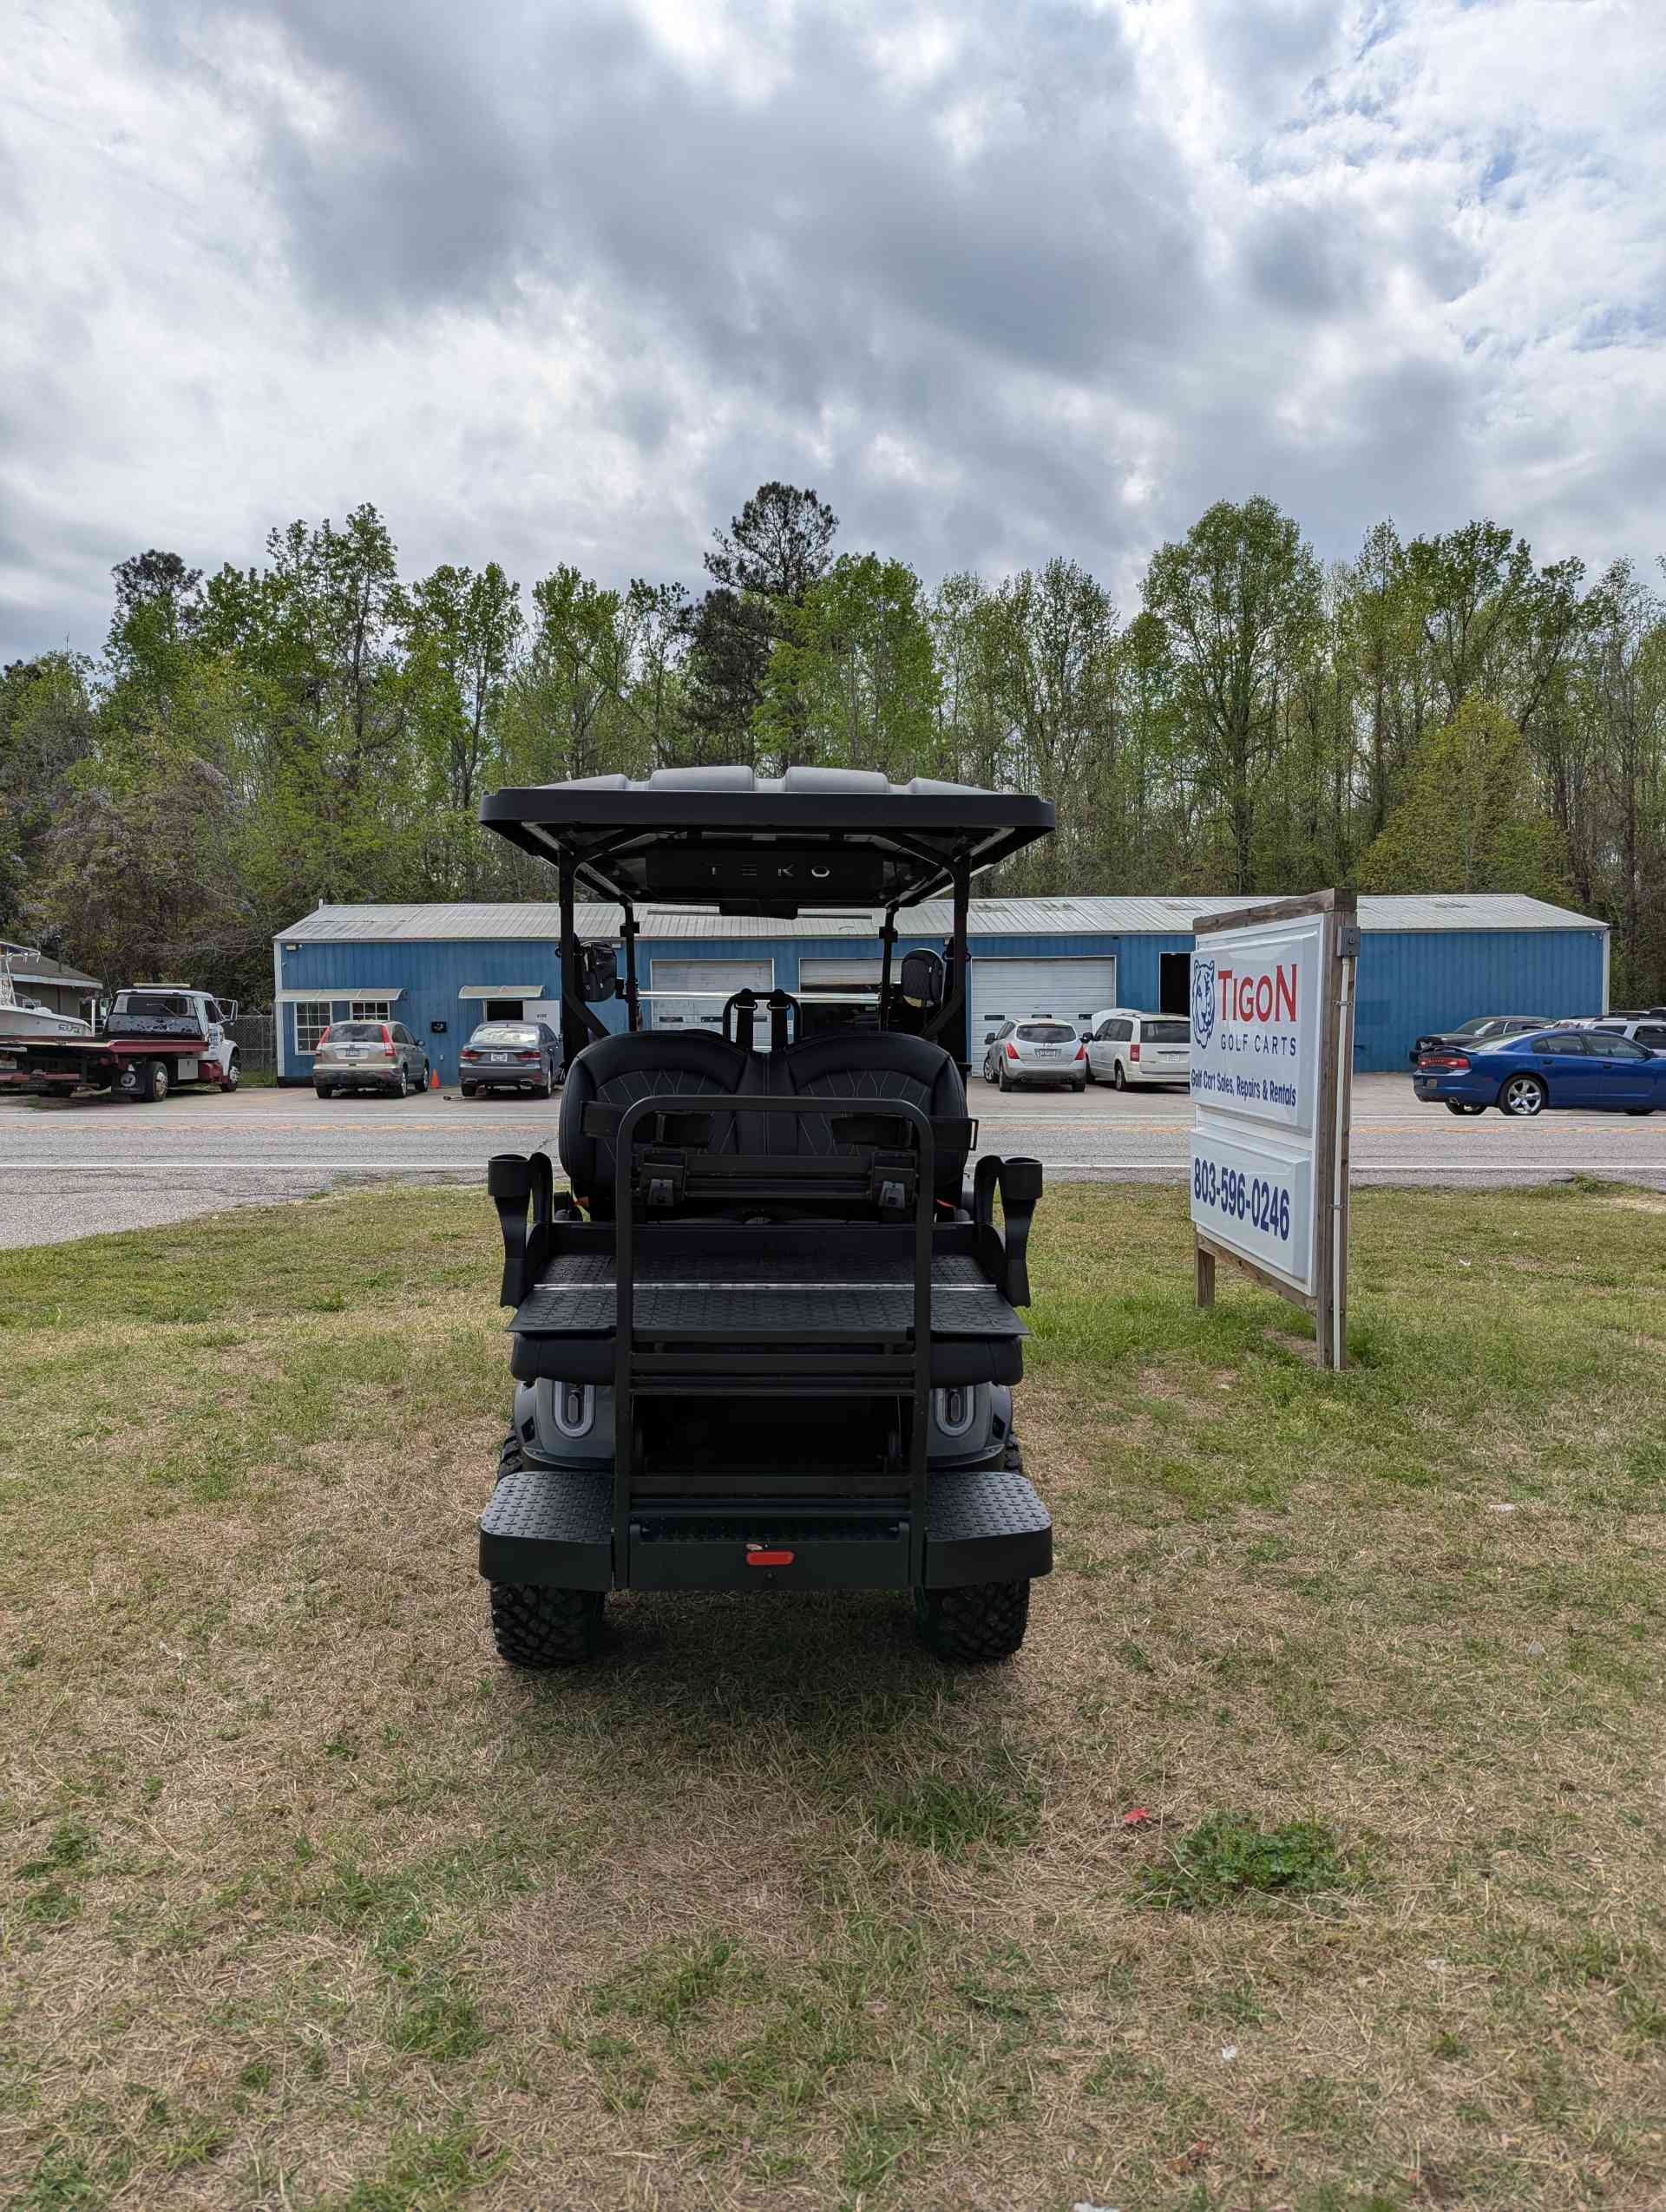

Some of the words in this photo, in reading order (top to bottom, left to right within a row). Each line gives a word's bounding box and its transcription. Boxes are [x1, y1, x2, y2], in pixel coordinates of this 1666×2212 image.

[1217, 964, 1297, 1022] TIGON
[1220, 1033, 1249, 1052] GOLF
[1254, 1034, 1296, 1057] CARTS
[1190, 1068, 1203, 1089] Golf
[1204, 1070, 1216, 1090] Cart
[1217, 1072, 1235, 1096] Sales,
[1236, 1075, 1261, 1102] Repairs
[1263, 1079, 1268, 1102] &
[1269, 1080, 1296, 1107] Rentals
[1194, 1157, 1290, 1240] 803-596-0246
